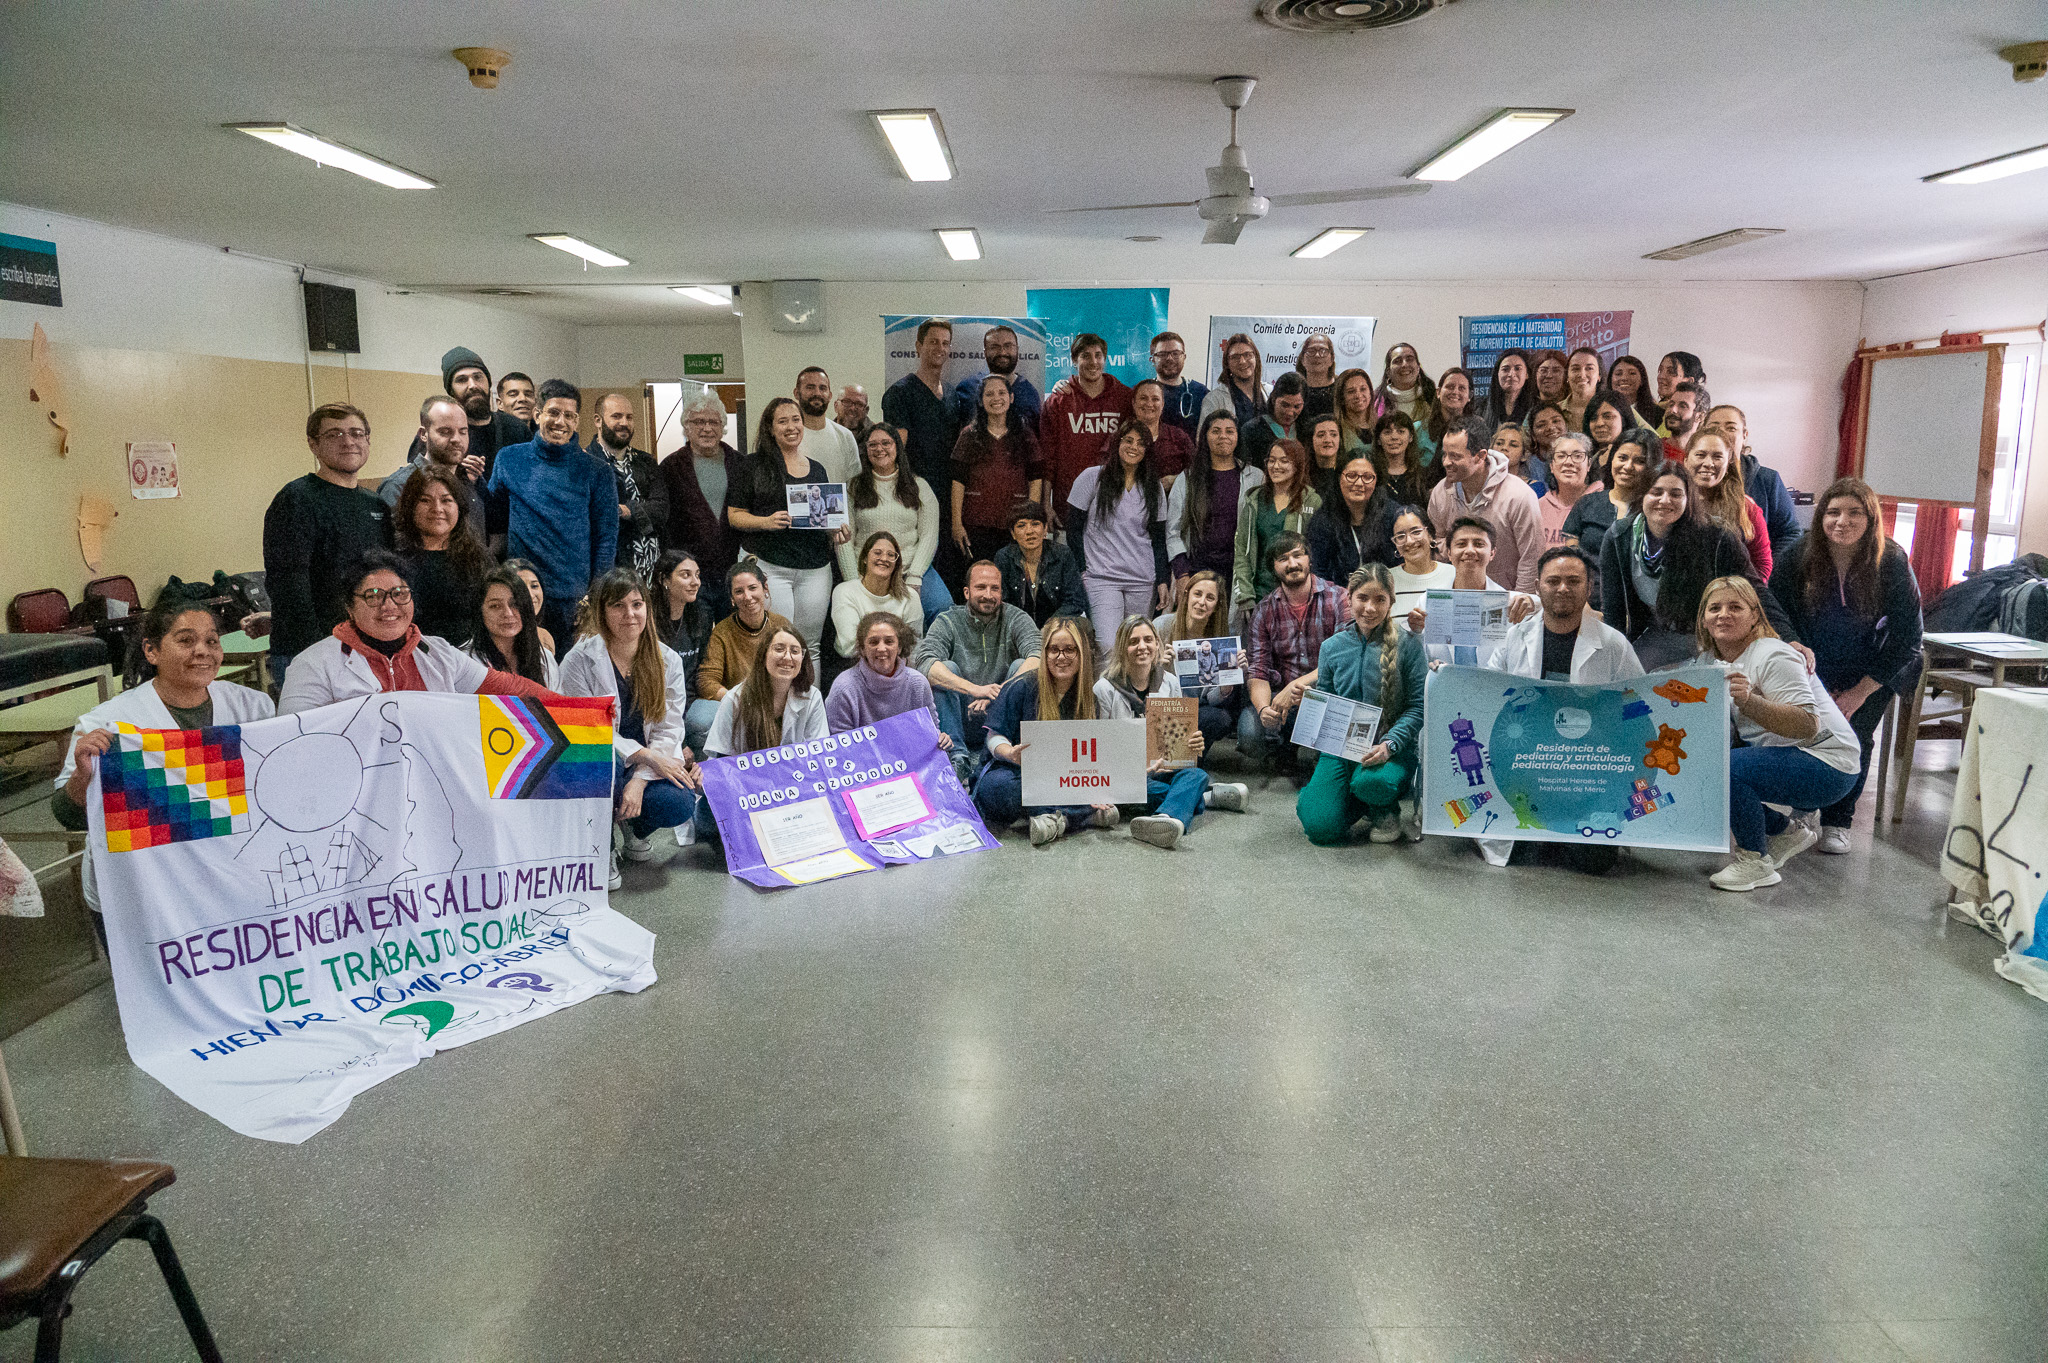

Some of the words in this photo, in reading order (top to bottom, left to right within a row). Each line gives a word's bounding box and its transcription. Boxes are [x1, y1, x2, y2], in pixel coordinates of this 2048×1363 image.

[1, 265, 24, 282] escriba
[23, 266, 33, 285] las
[34, 270, 59, 289] paredes
[1253, 323, 1282, 334] Comité
[1284, 324, 1295, 334] de
[1297, 324, 1336, 335] Docencia
[1471, 322, 1508, 335] RESIDENCIAS
[1508, 322, 1516, 334] DE
[1517, 322, 1525, 333] LA
[1526, 321, 1563, 333] MATERNIDAD
[1564, 311, 1614, 340] oreno
[1046, 332, 1081, 350] Regi
[1292, 341, 1297, 349] e
[1470, 338, 1478, 350] DE
[1479, 337, 1504, 349] MORENO
[1504, 336, 1525, 349] ESTELA
[1525, 336, 1533, 348] DE
[1534, 335, 1564, 348] CARLOTTO
[968, 352, 985, 360] SAL
[1108, 354, 1125, 366] VII
[1266, 353, 1298, 366] Investig
[1068, 411, 1120, 434] VANS
[738, 730, 876, 769] RESIDENCIA
[1536, 744, 1593, 753] Residencia
[1596, 744, 1610, 753] de
[1515, 752, 1563, 762] pediatría
[1566, 754, 1572, 763] y
[1574, 753, 1631, 763] articulada
[1511, 761, 1635, 773] pediatría/neonatología
[740, 789, 796, 808] JUANA
[817, 763, 904, 791] AZURDUY
[1059, 775, 1110, 787] MORON
[1538, 777, 1568, 786] Hospital
[1569, 777, 1596, 785] Heroes
[158, 902, 365, 985] RESIDENCIA
[367, 889, 419, 931] EN
[424, 871, 510, 918] SALUD
[514, 863, 603, 902] MENTAL
[258, 967, 311, 1013] DE
[320, 928, 456, 992] TRABAJO
[460, 911, 535, 955] SOIAL
